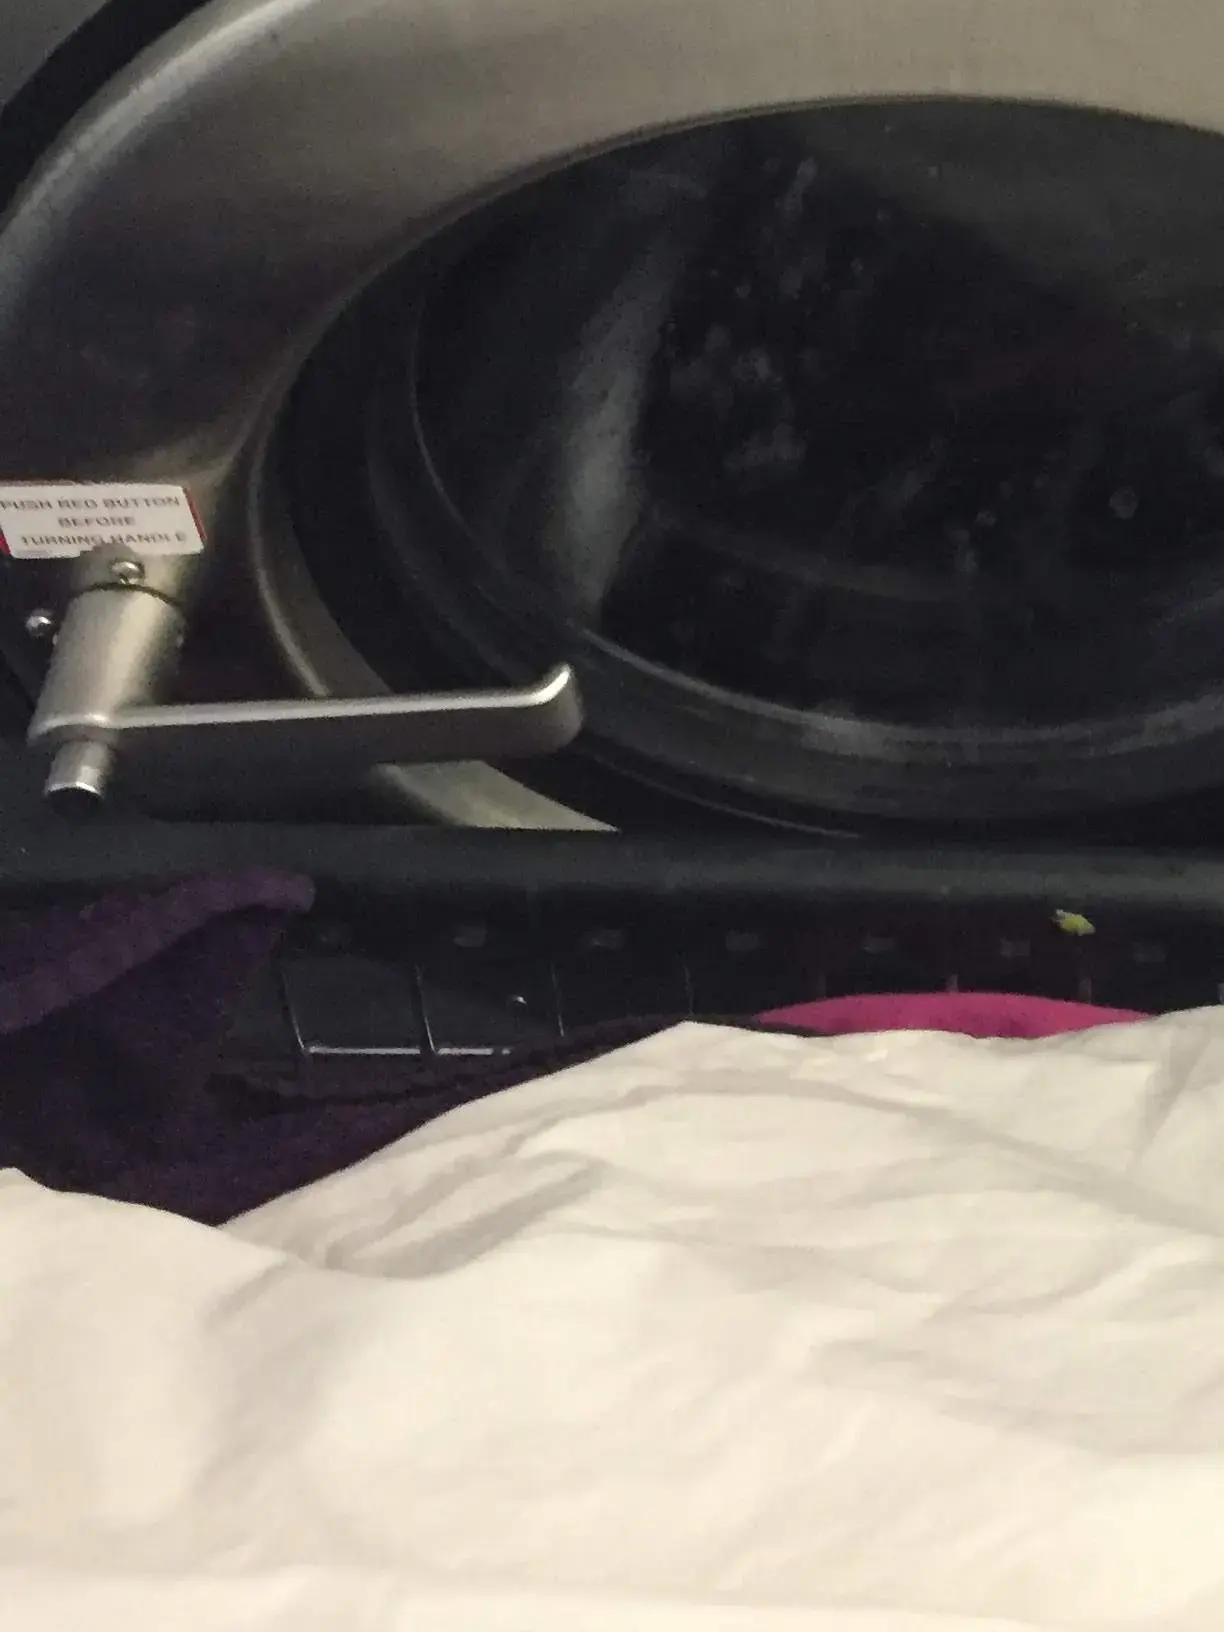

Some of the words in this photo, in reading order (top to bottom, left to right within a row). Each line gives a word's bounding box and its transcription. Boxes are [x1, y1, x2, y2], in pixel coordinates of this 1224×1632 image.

[0, 499, 53, 511] PUSH
[57, 499, 99, 510] RED
[102, 496, 180, 509] BUTTON
[57, 516, 137, 528] BEFORE
[21, 534, 104, 546] TURNING
